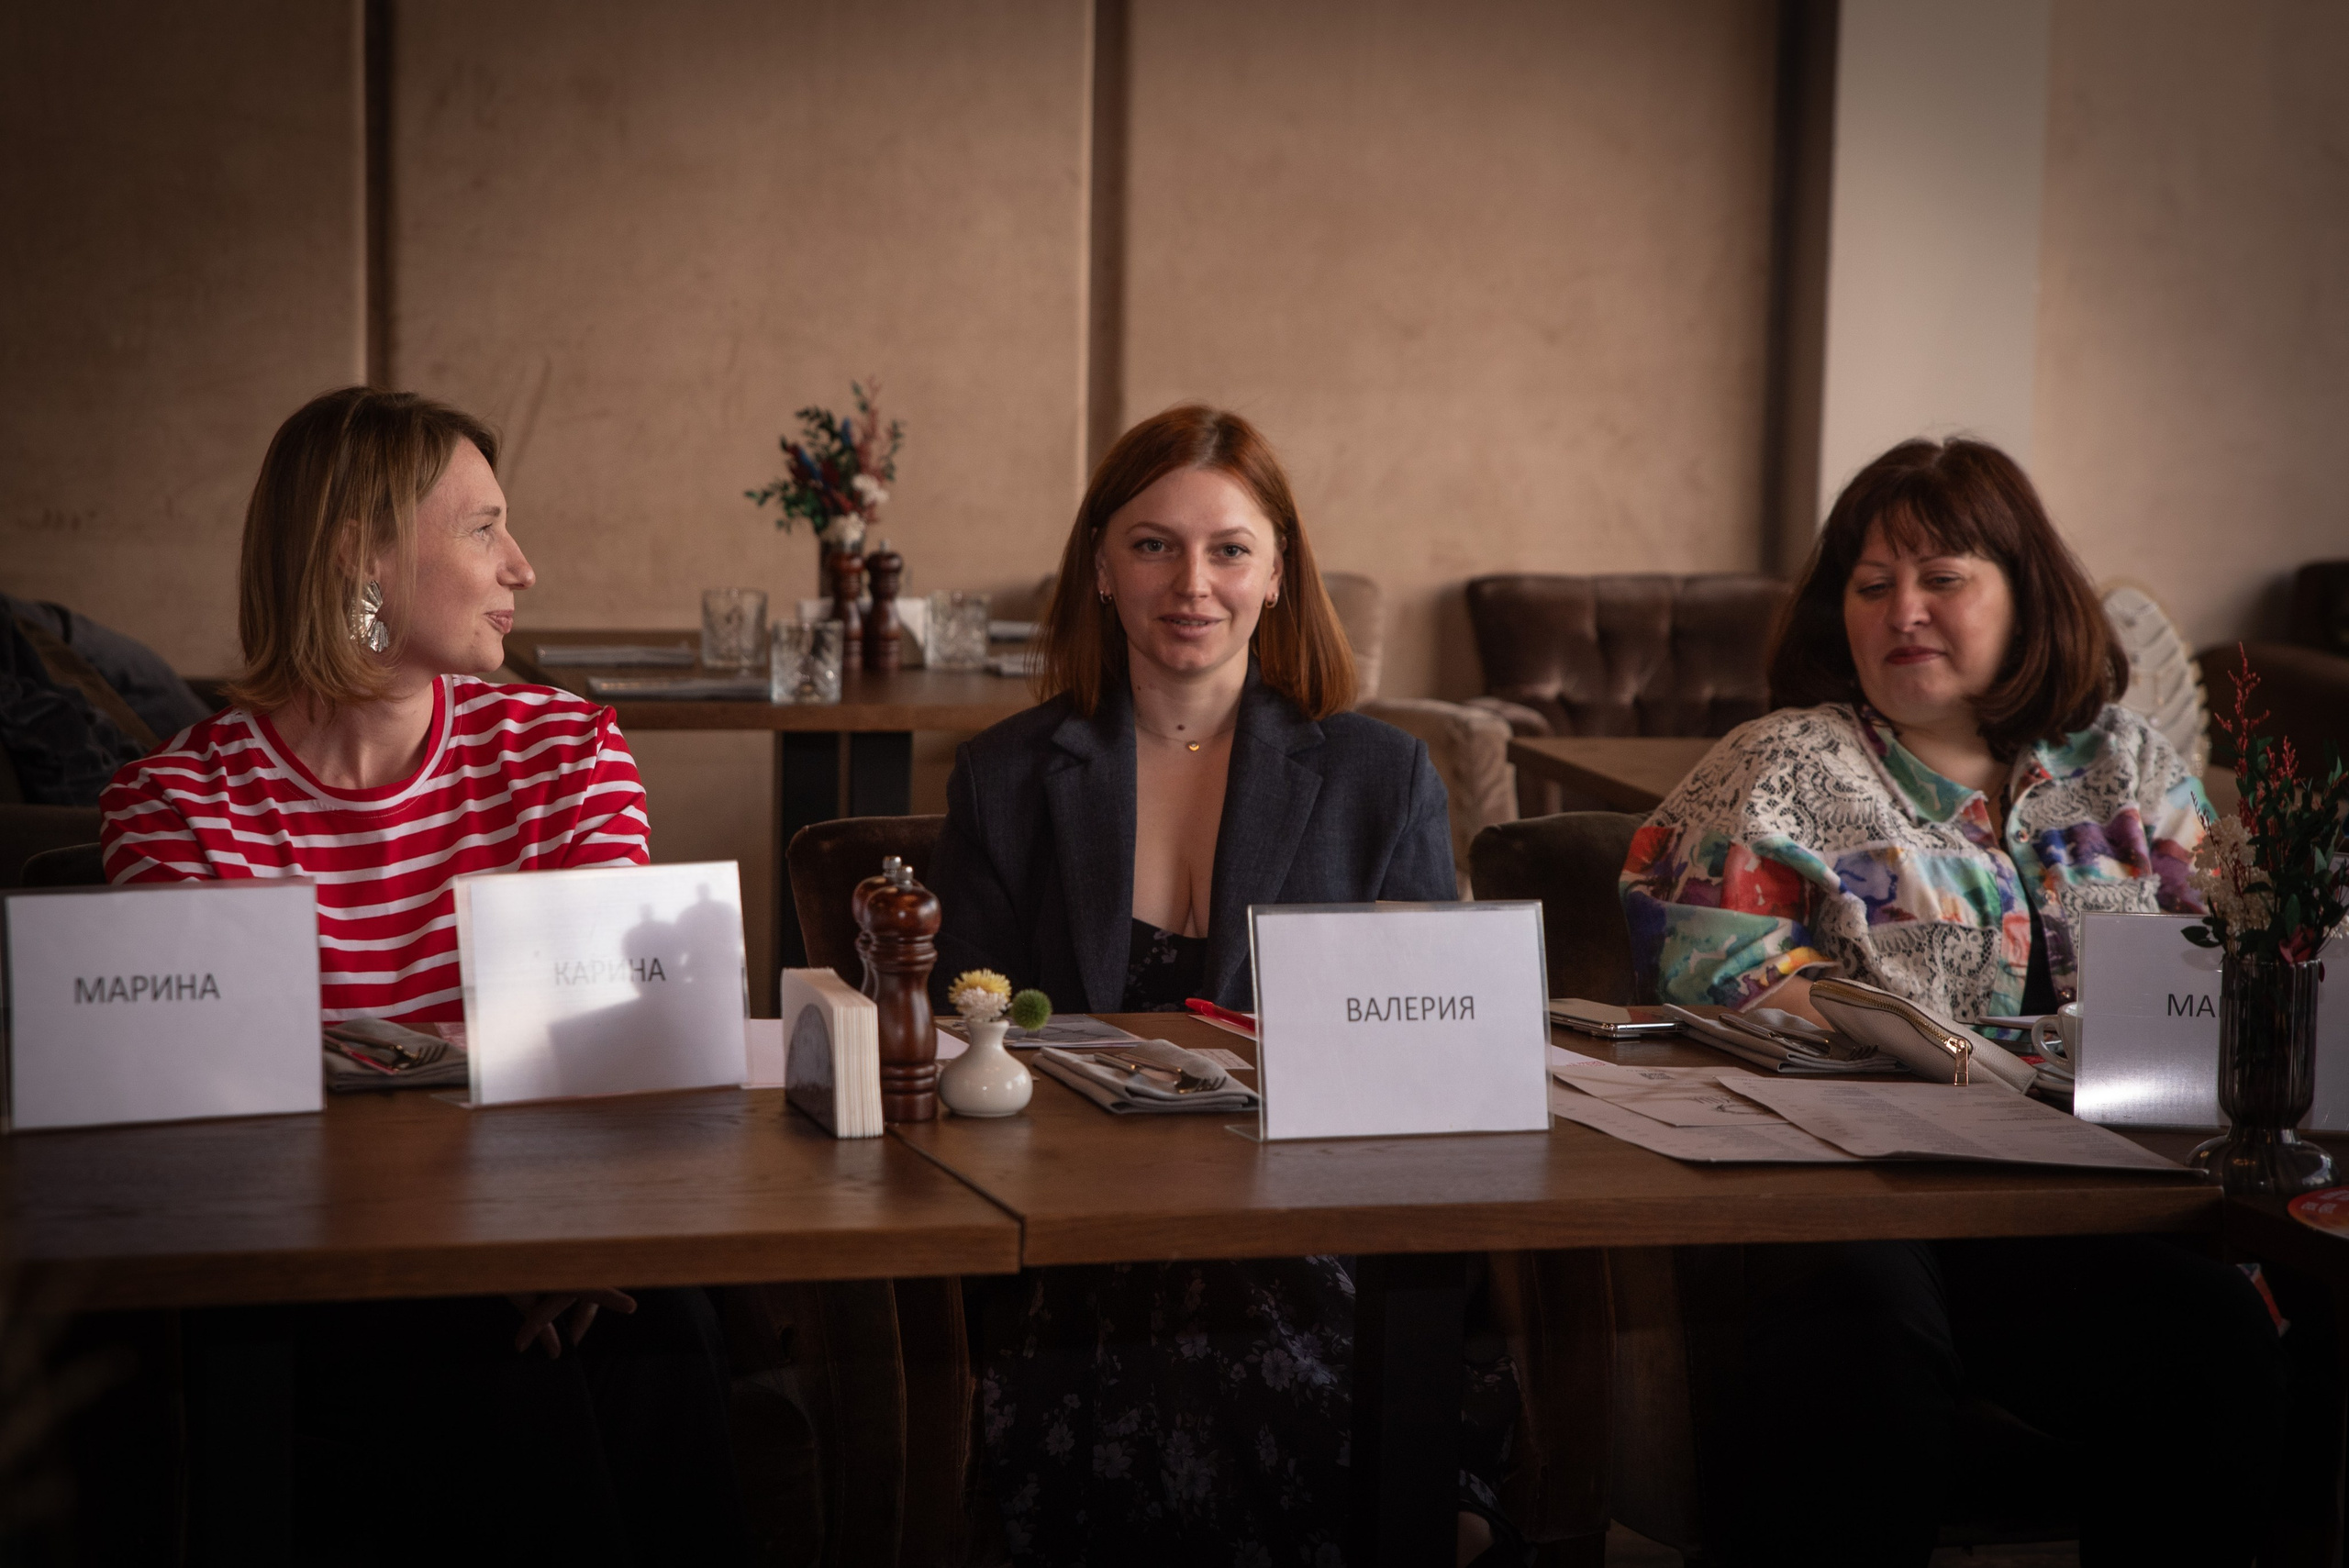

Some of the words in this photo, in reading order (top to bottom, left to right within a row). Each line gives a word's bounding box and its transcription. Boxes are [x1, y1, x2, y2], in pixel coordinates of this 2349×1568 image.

[554, 957, 666, 985] КАРИНА
[74, 973, 221, 1004] МАРИНА
[1347, 995, 1475, 1022] ВАЛЕРИЯ
[2166, 993, 2221, 1018] МА
